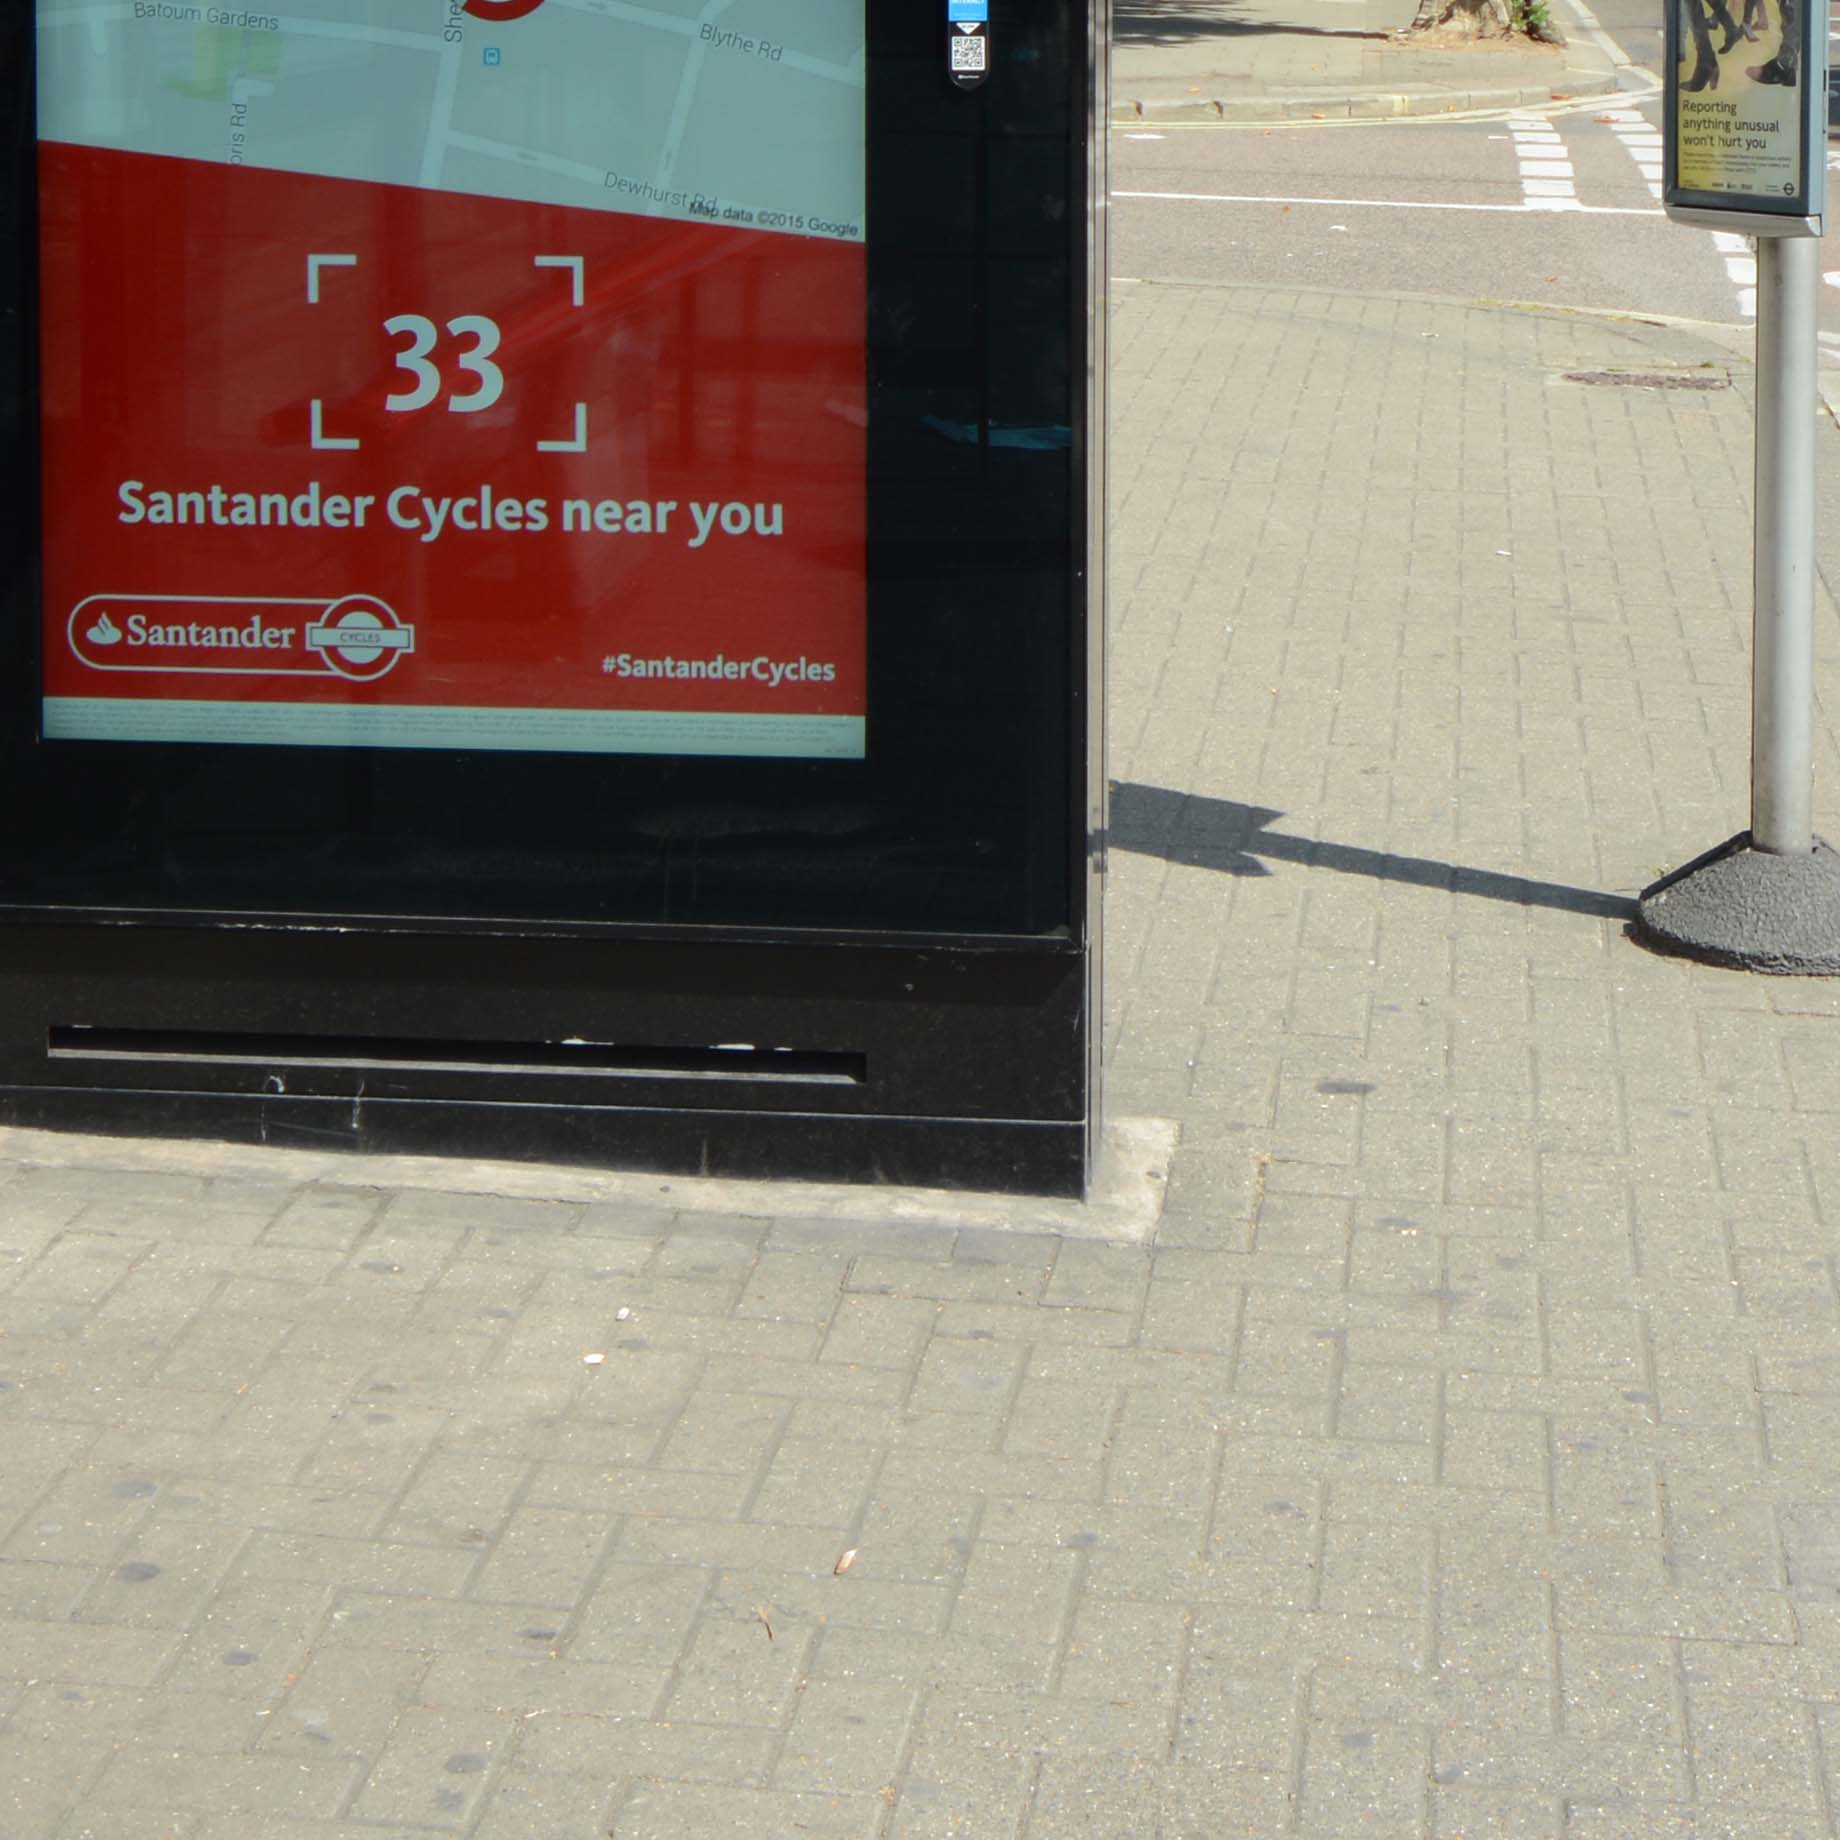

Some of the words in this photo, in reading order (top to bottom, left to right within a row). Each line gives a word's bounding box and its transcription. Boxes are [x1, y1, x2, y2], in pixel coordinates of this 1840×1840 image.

[134, 1, 201, 22] Batoum
[207, 8, 279, 31] Gardens
[700, 23, 754, 54] Blythe
[757, 41, 783, 62] Rd
[230, 103, 248, 128] Rd
[1682, 99, 1737, 116] Reporting
[1682, 118, 1731, 134] anything
[1735, 119, 1780, 133] unusual
[1683, 135, 1715, 147] won't
[1718, 135, 1742, 148] hurt
[1745, 138, 1767, 151] you
[604, 171, 689, 208] Dewhurst
[689, 201, 719, 219] Map
[723, 208, 754, 223] data
[757, 211, 805, 229] ©2015
[808, 217, 859, 237] Google
[383, 313, 505, 413] 33
[118, 479, 374, 528] Santander
[387, 485, 549, 543] Cycles
[562, 497, 678, 536] near
[688, 501, 784, 548] you
[126, 613, 295, 649] Santander
[338, 632, 382, 644] CYCLES
[603, 653, 836, 687] #SantanderCycles
